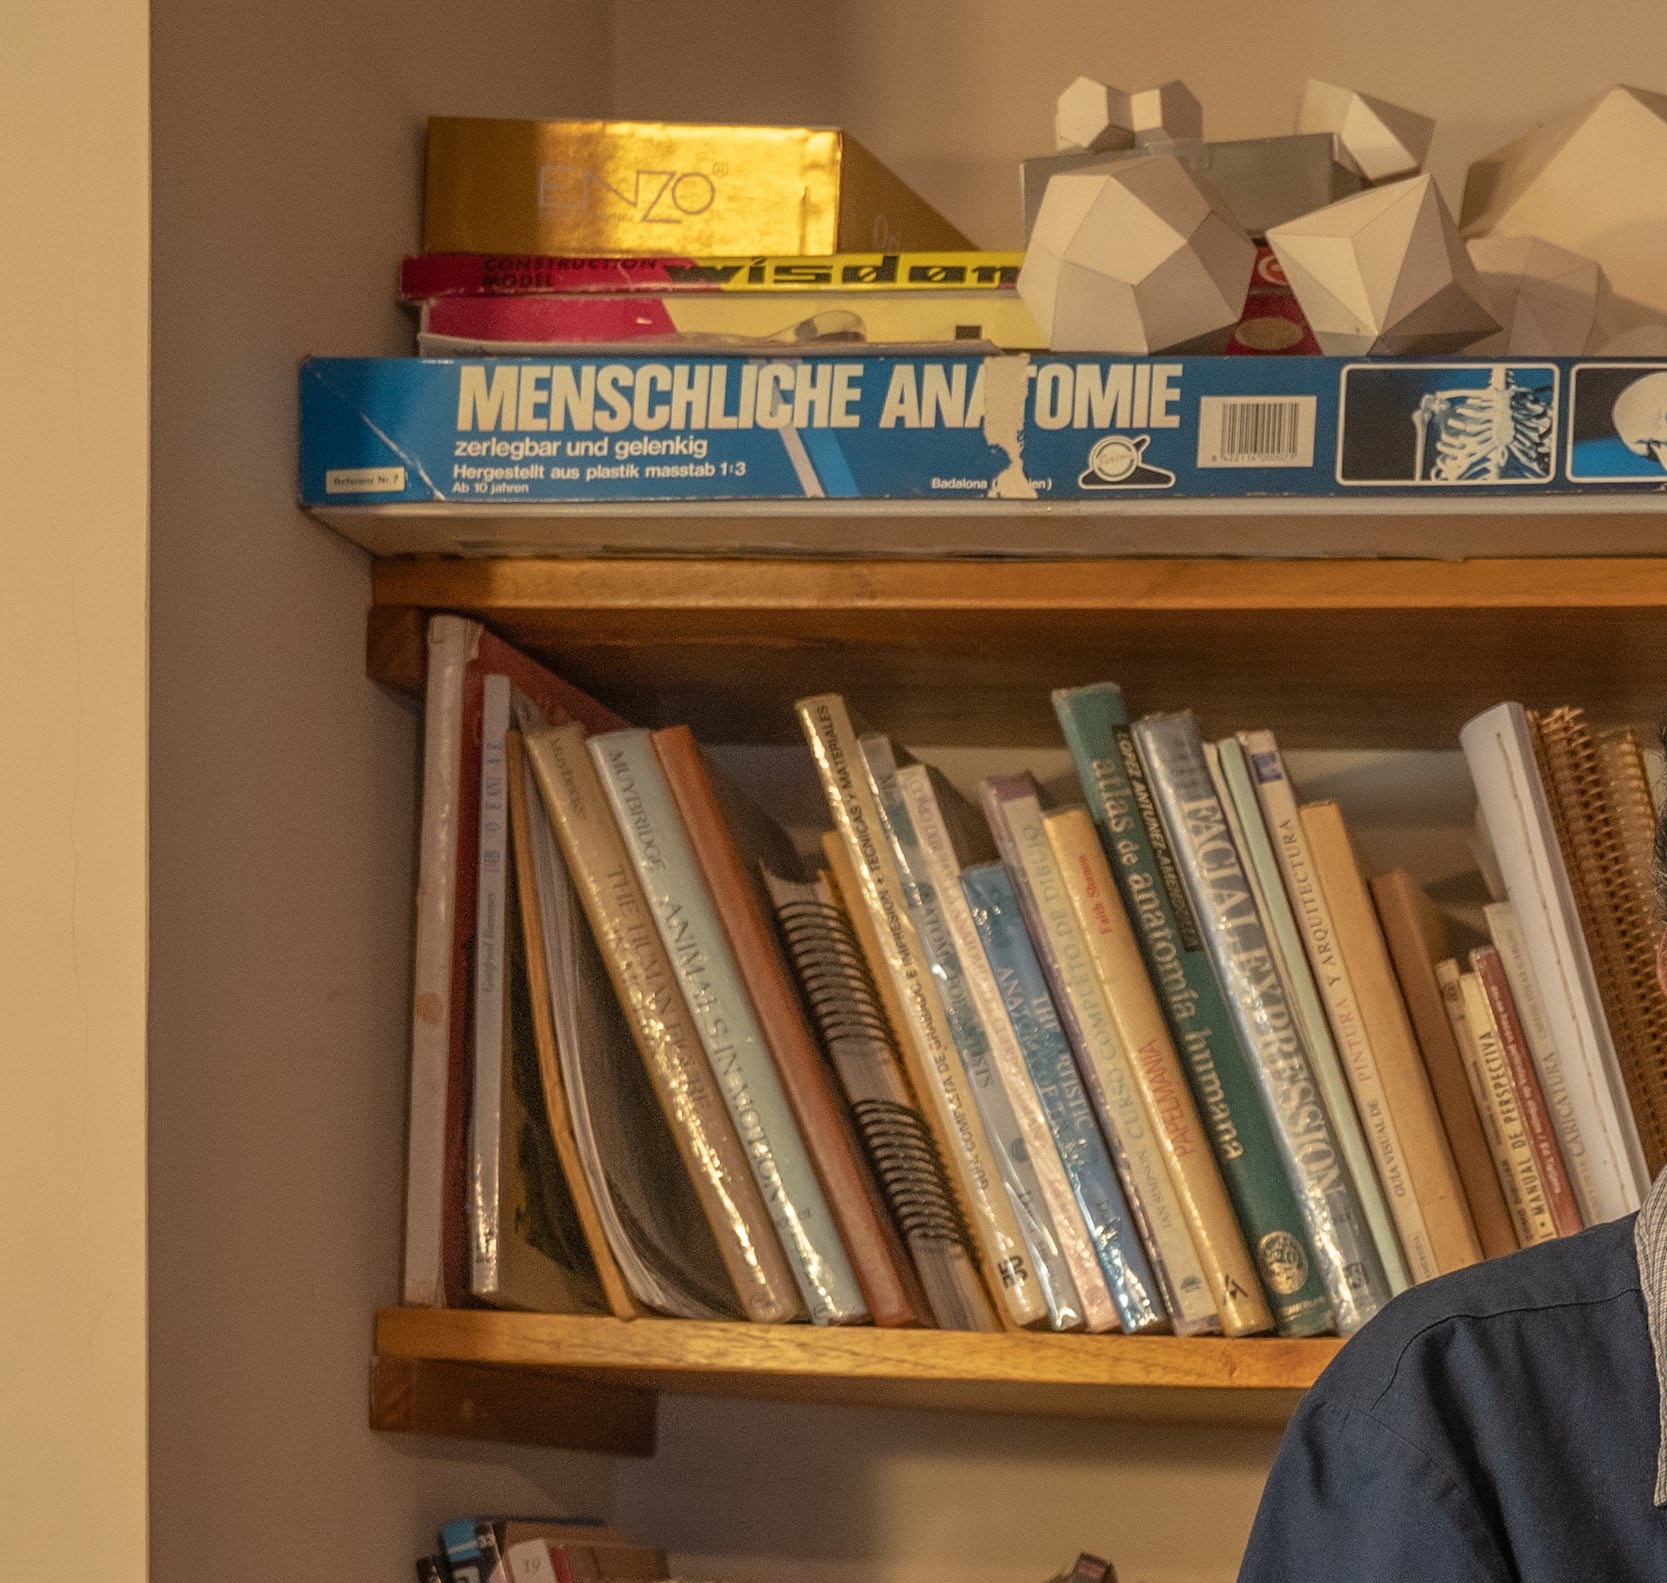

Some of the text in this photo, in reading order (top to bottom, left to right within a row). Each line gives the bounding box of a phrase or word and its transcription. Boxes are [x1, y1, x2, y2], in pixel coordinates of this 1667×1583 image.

[457, 363, 1184, 432] MENSCHLICHE ANAOMIE
[453, 462, 747, 482] Hergestellt aus plastik masstab 1:3
[454, 437, 708, 460] zerlegbar und gelenkig
[1175, 788, 1263, 937] FACIAL
[1276, 818, 1337, 969] ARQUITECTURA
[1050, 906, 1074, 938] DE
[1087, 752, 1253, 1163] atlas de anatomía humana
[1061, 941, 1118, 1062] COMPLETO
[1326, 973, 1341, 986] Y
[1333, 997, 1373, 1083] PINTURA
[1106, 1064, 1147, 1142] CURSO
[1132, 1038, 1202, 1160] PAPELMANIA
[1366, 1098, 1379, 1110] DE
[1370, 1110, 1396, 1163] VISUAL
[1475, 1030, 1549, 1217] MANUAL DE PERSPECTIVA
